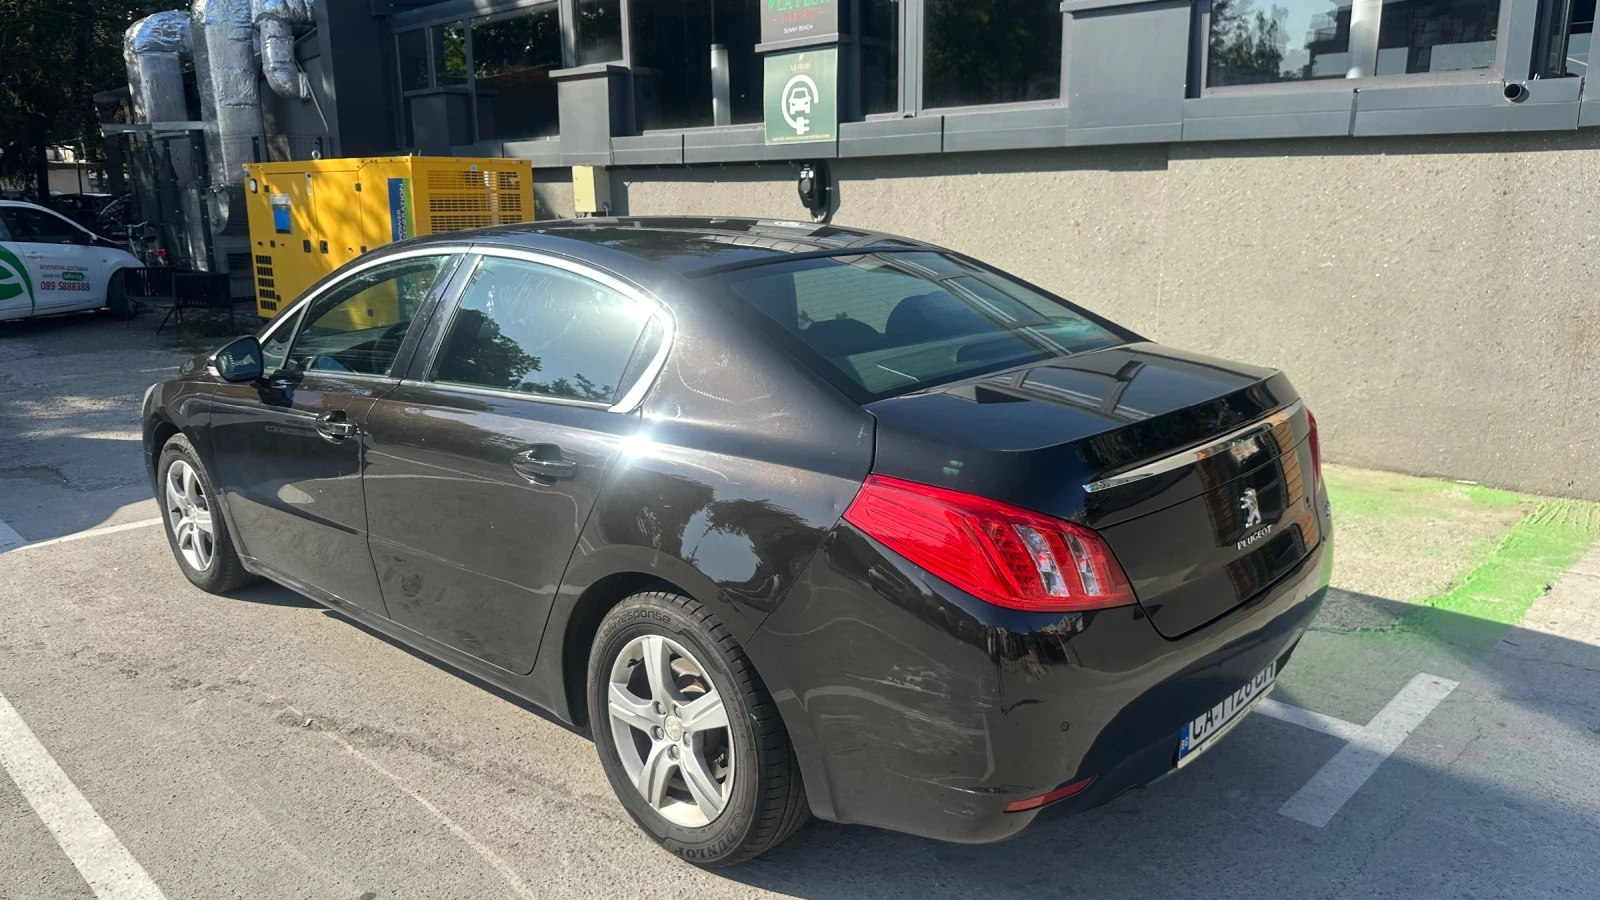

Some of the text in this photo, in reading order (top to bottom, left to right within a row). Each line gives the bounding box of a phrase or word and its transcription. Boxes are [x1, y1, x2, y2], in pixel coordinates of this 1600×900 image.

[783, 23, 814, 34] SUNNY BEACH
[40, 281, 90, 291] 089 5888388
[1237, 525, 1272, 550] PEUGEOT
[674, 828, 738, 859] DUNLOP
